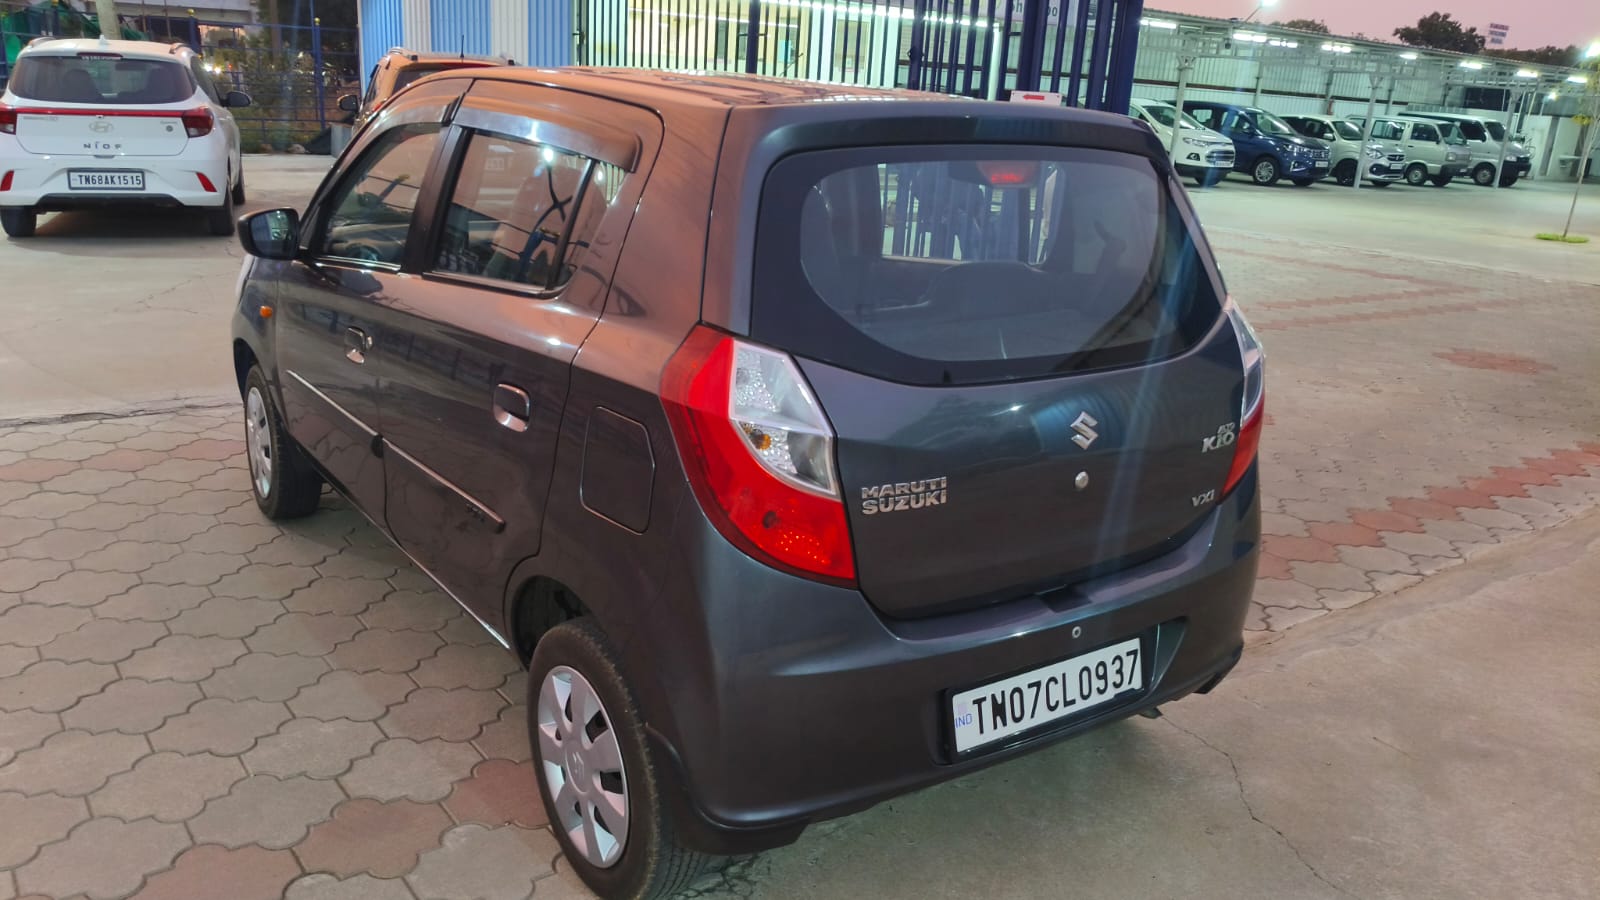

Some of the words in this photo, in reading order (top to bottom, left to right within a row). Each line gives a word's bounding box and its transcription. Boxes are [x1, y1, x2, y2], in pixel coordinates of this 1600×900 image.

[78, 174, 142, 185] TN68AK1515
[861, 476, 947, 499] MARUTI
[862, 489, 947, 515] SUZUKI
[955, 713, 972, 728] IND
[973, 649, 1138, 734] TN07CL0937
